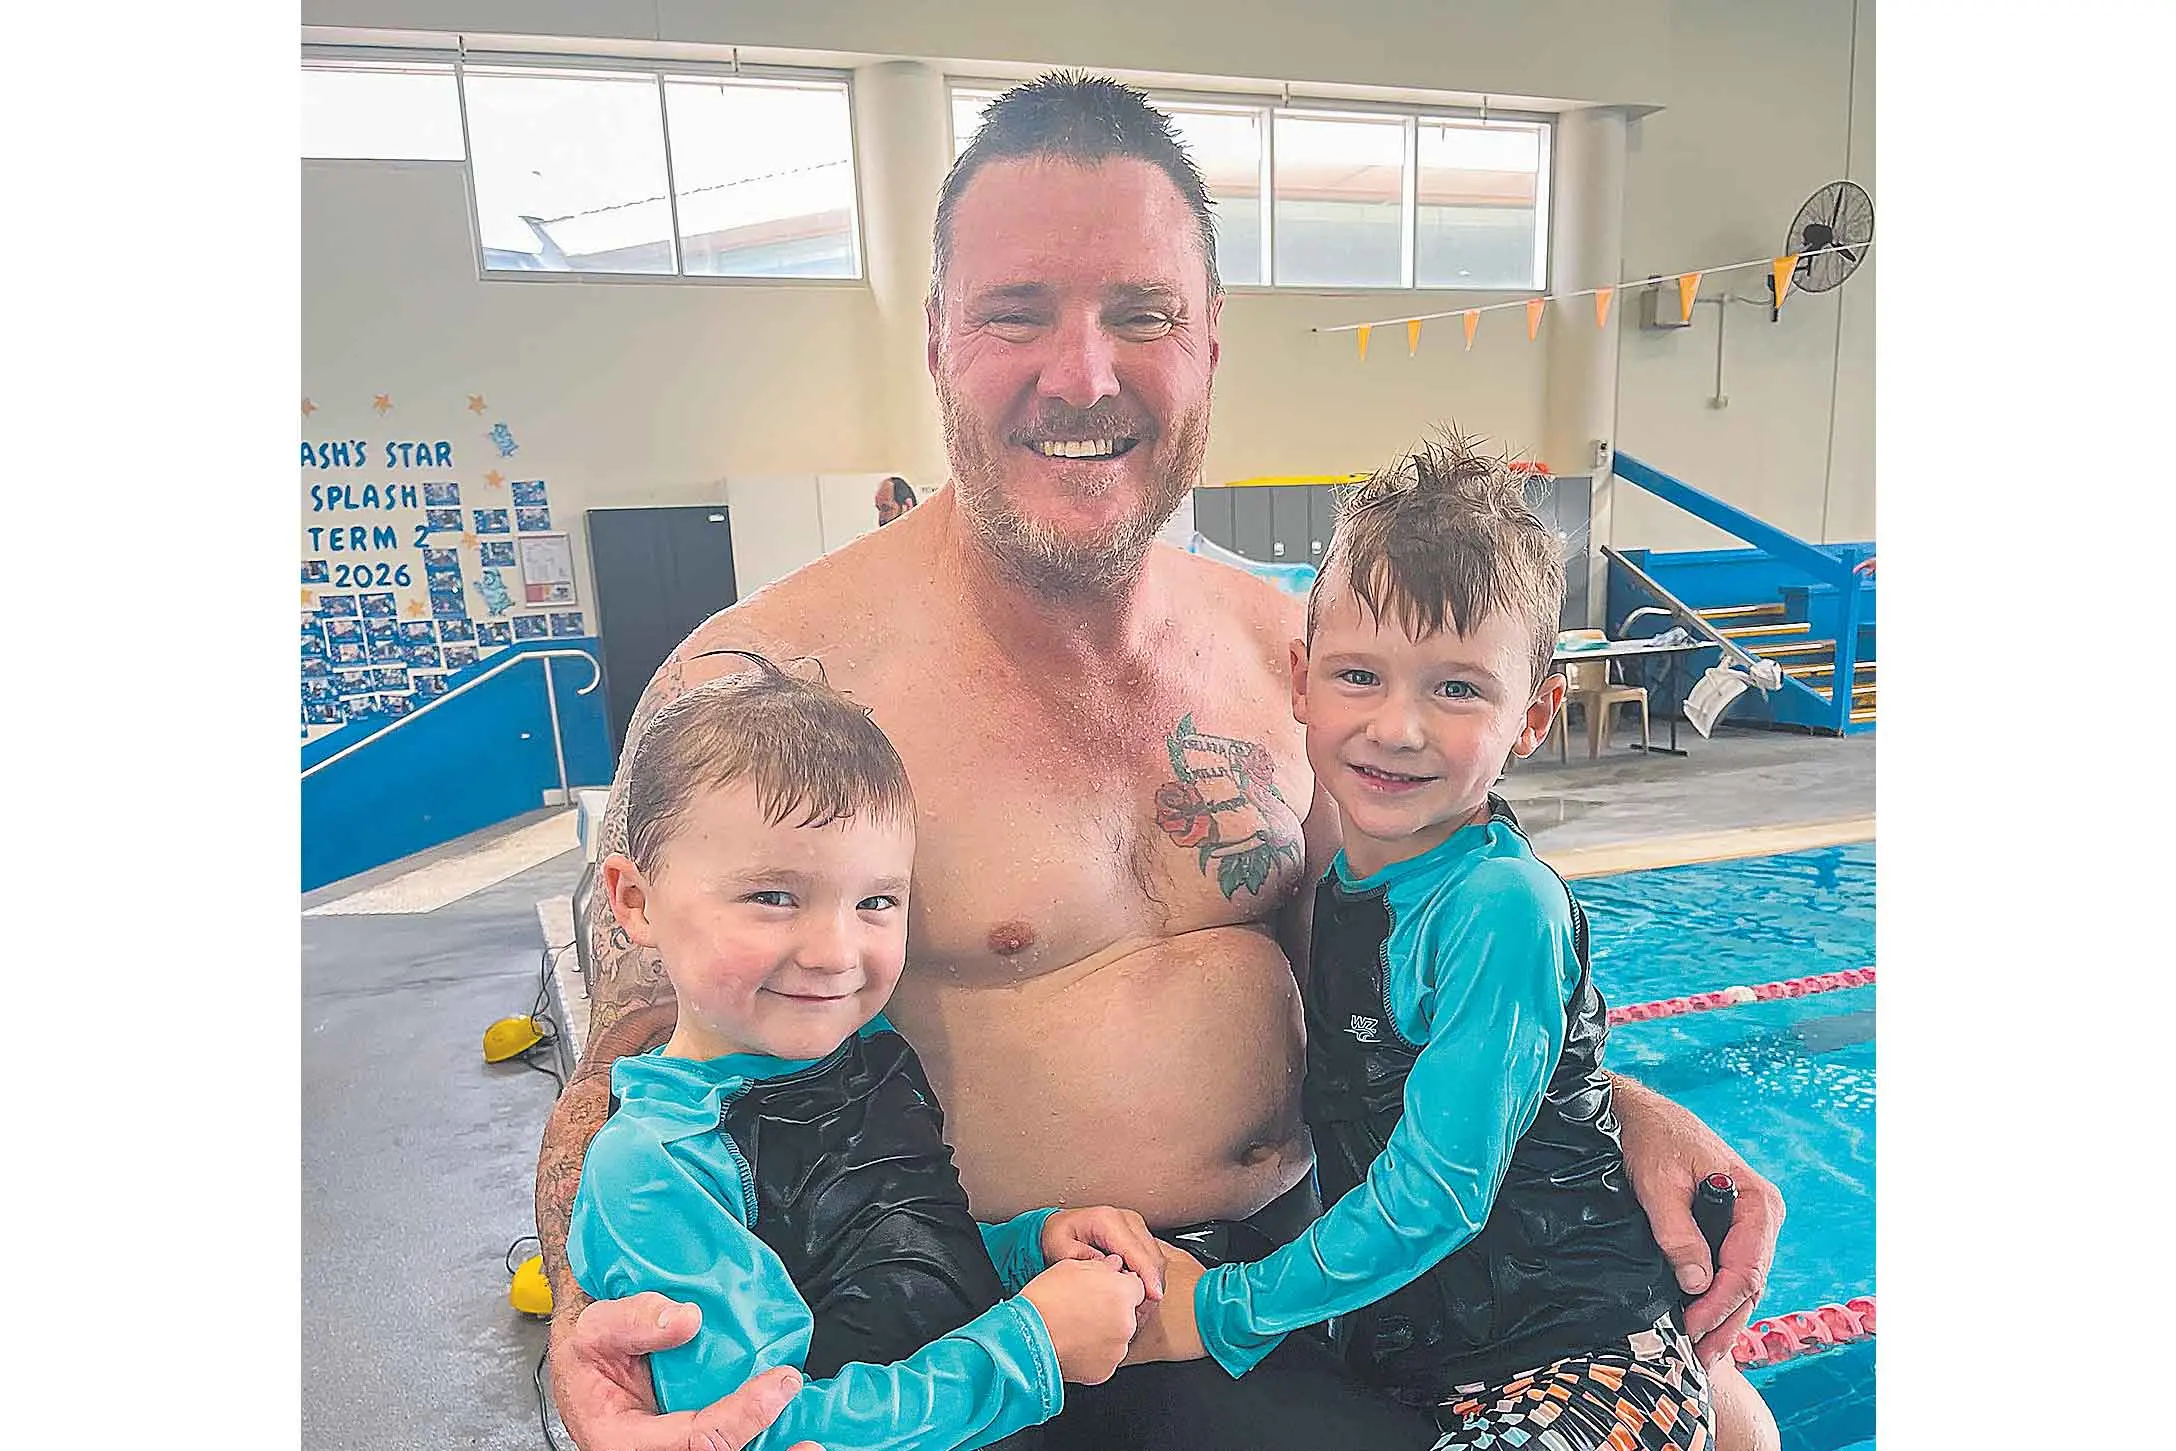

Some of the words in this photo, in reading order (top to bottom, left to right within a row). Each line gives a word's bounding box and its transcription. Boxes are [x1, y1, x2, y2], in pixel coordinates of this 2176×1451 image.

[301, 440, 367, 469] ASH'S
[385, 441, 453, 468] STAR
[311, 484, 418, 512] SPLASH
[307, 525, 398, 552] TERM
[414, 524, 430, 548] 2
[335, 563, 412, 588] 2026
